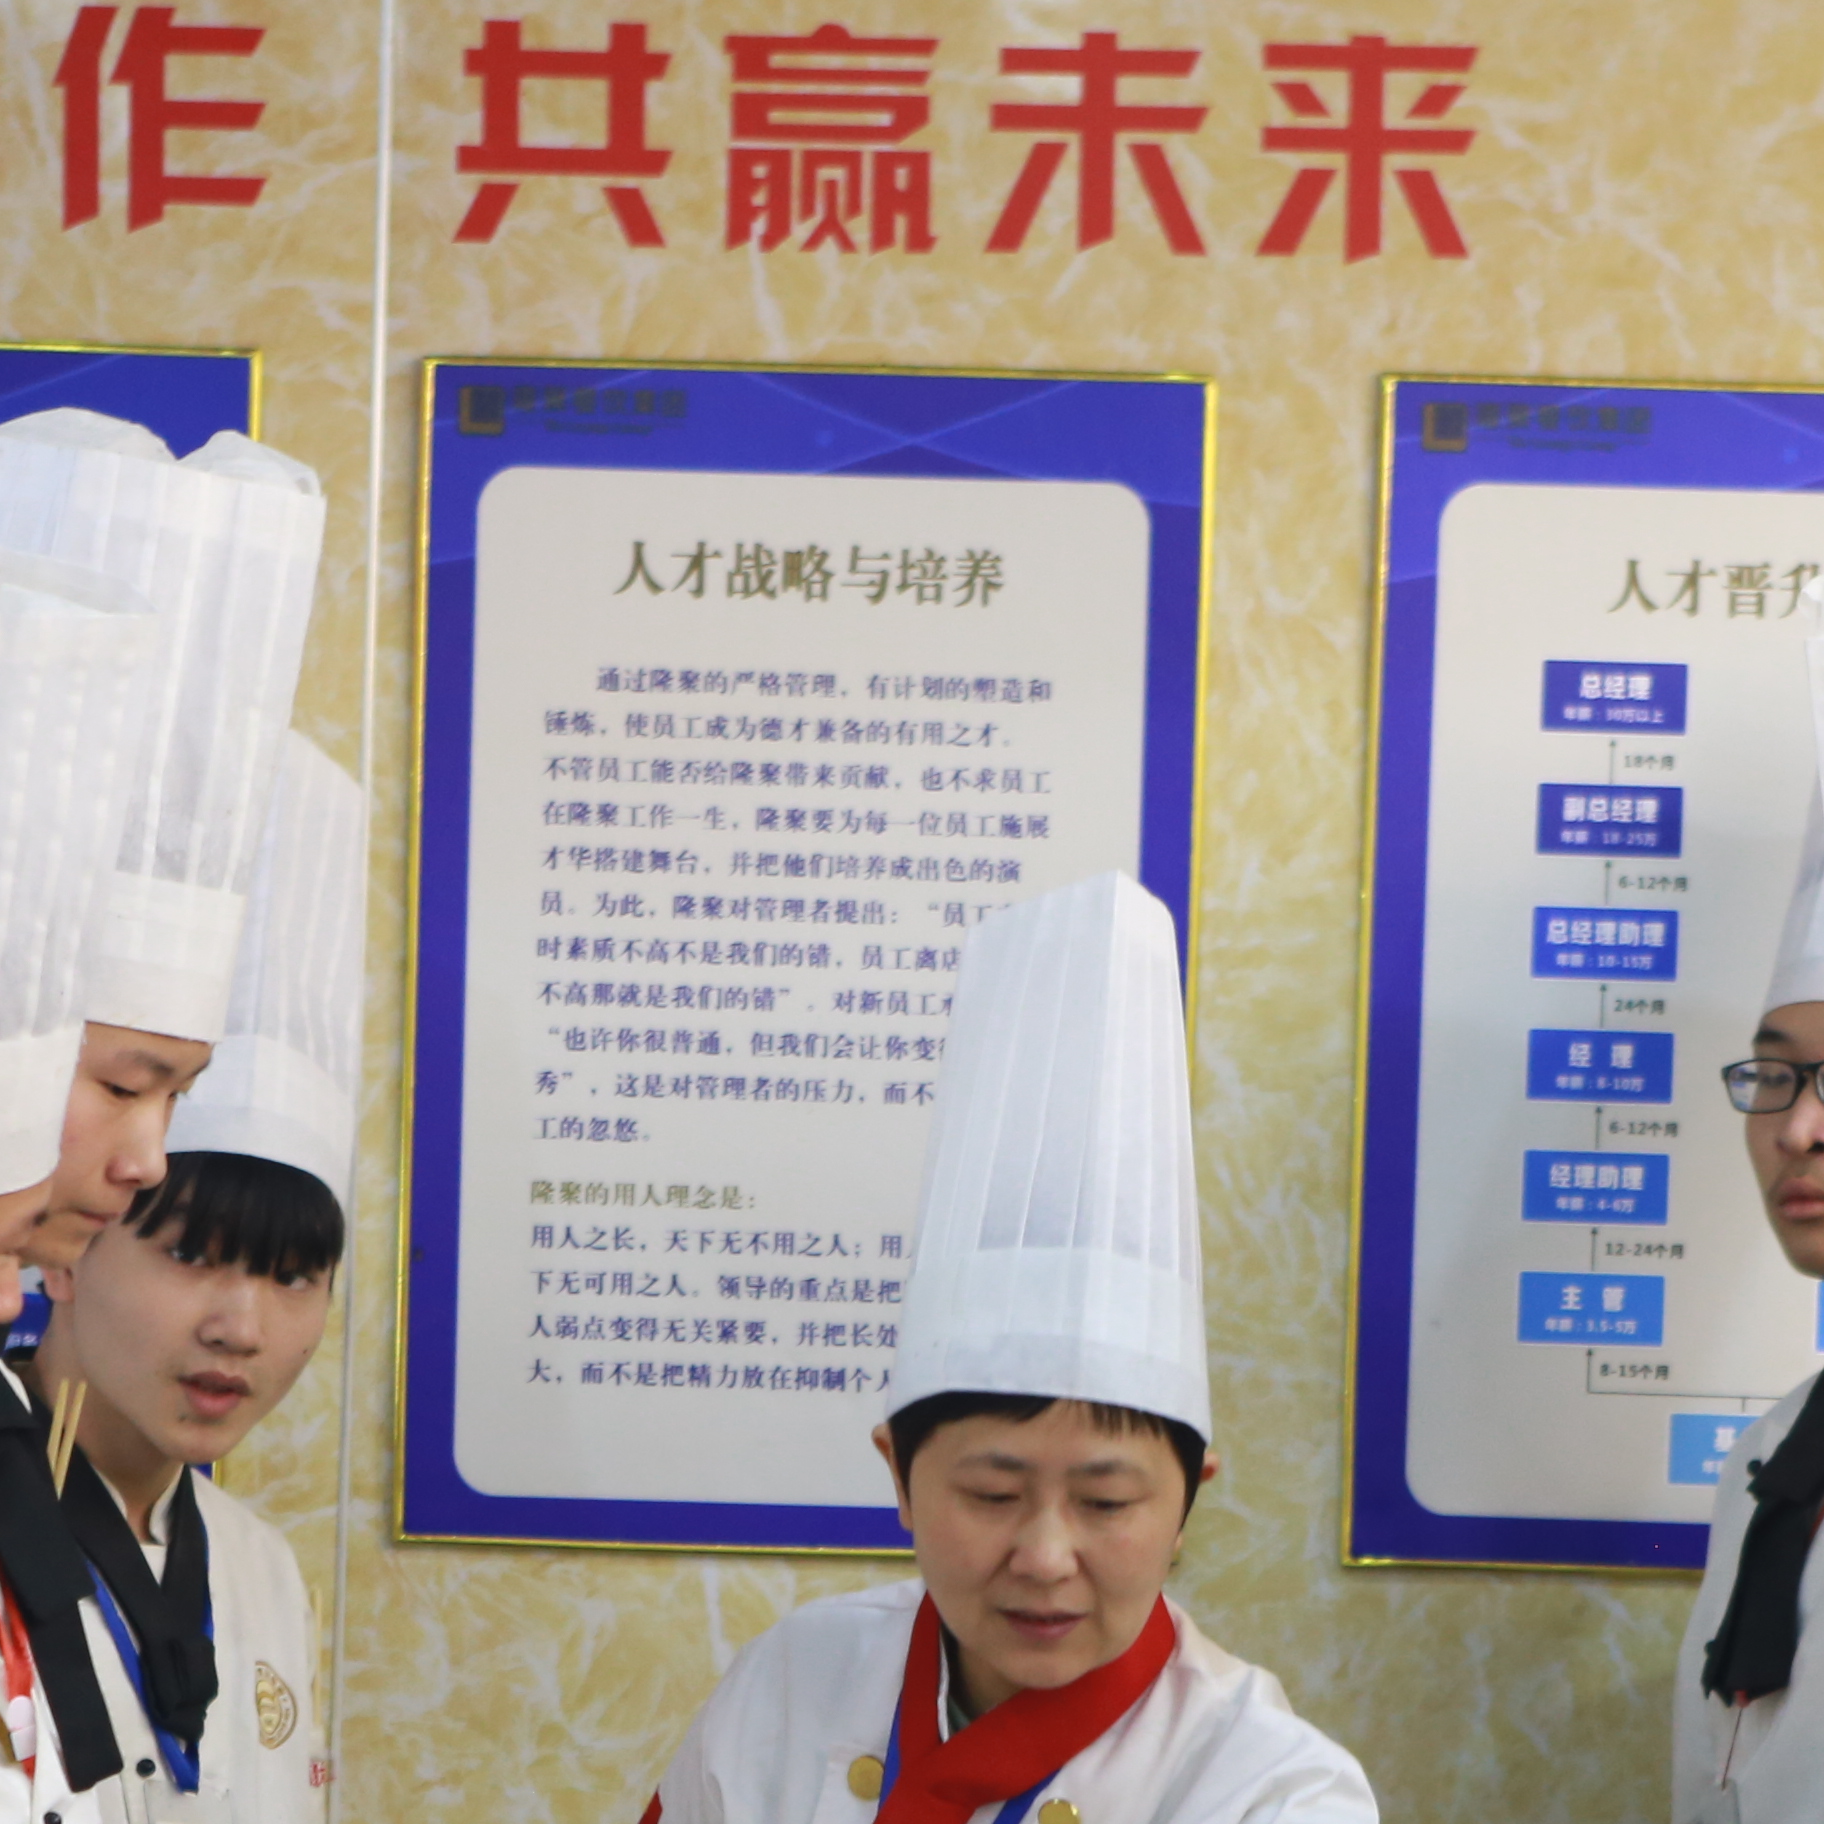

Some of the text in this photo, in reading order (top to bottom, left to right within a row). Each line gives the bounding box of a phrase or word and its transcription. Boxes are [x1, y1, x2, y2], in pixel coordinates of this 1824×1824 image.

[456, 20, 1477, 262] 共赢未来
[613, 540, 1005, 608] 人才战略与培养
[1579, 673, 1652, 700] 总经理
[1562, 797, 1659, 823] 副总经理
[1546, 919, 1666, 947] 总经理助理
[548, 1026, 946, 1062] “也许你很普通，但我们会让你变
[533, 1115, 651, 1143] 工的忽悠。
[1549, 1163, 1645, 1190] 经理助理
[531, 1224, 912, 1259] 用人之长，天下无不用之人；用
[1605, 1243, 1685, 1259] 12-24个月
